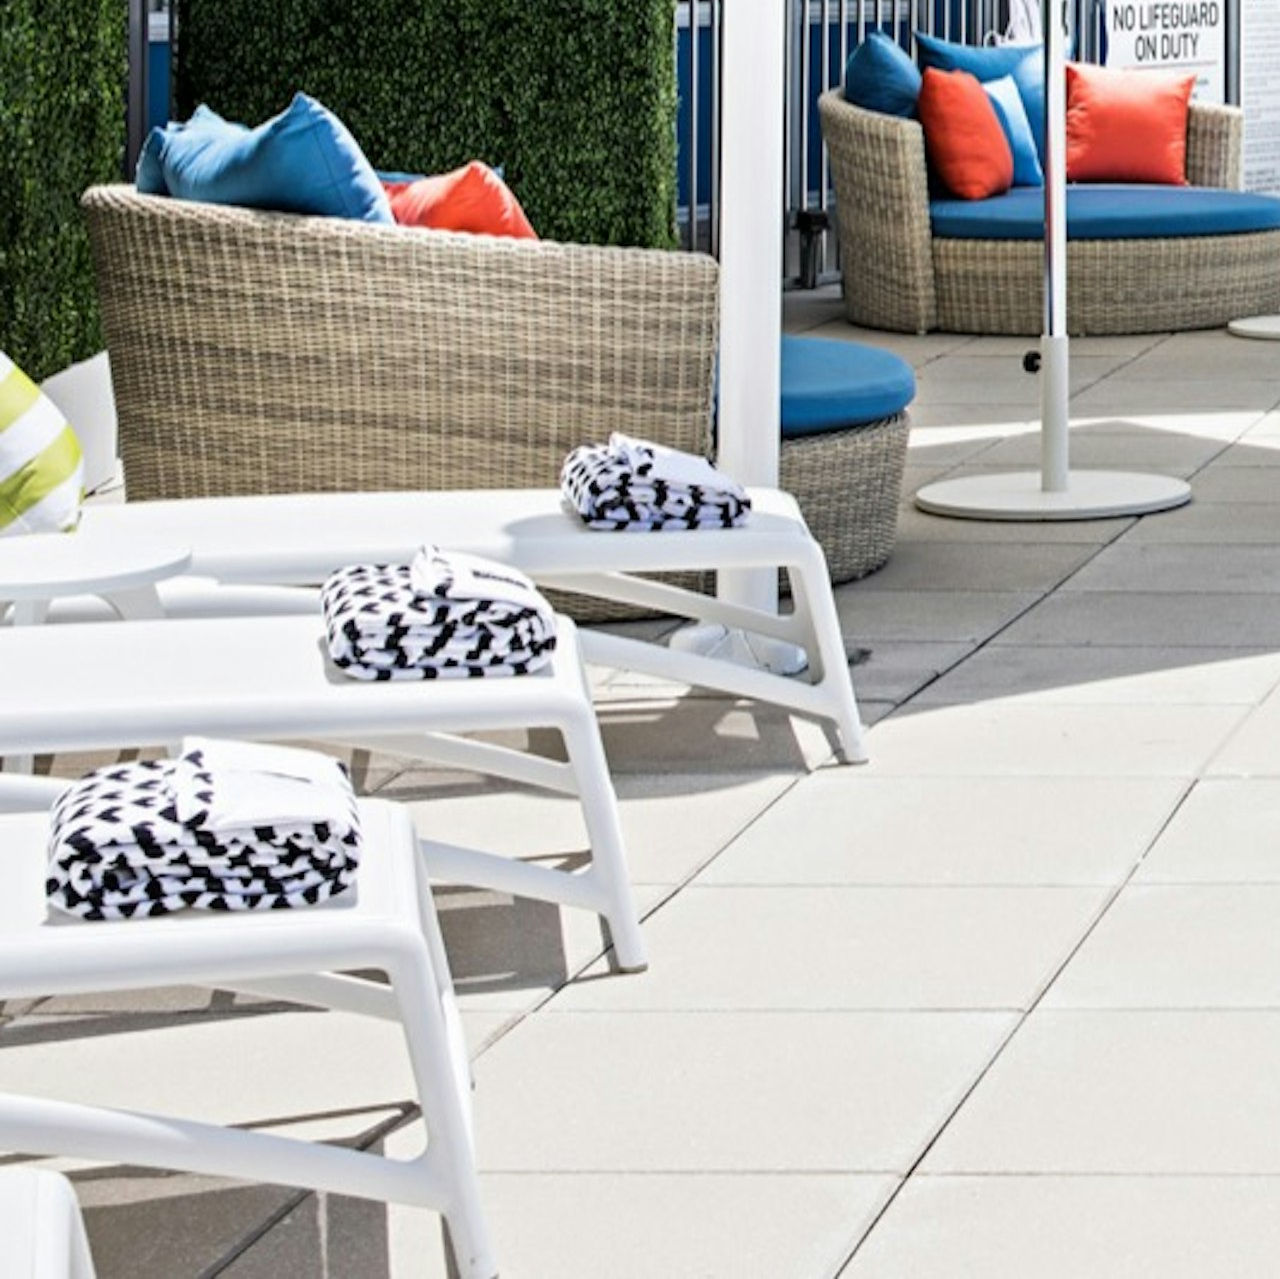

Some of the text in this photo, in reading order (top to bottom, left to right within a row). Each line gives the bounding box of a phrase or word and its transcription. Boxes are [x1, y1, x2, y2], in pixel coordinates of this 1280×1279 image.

[1113, 1, 1219, 32] NO LIFEGUARD
[1135, 33, 1199, 62] ON DUTY
